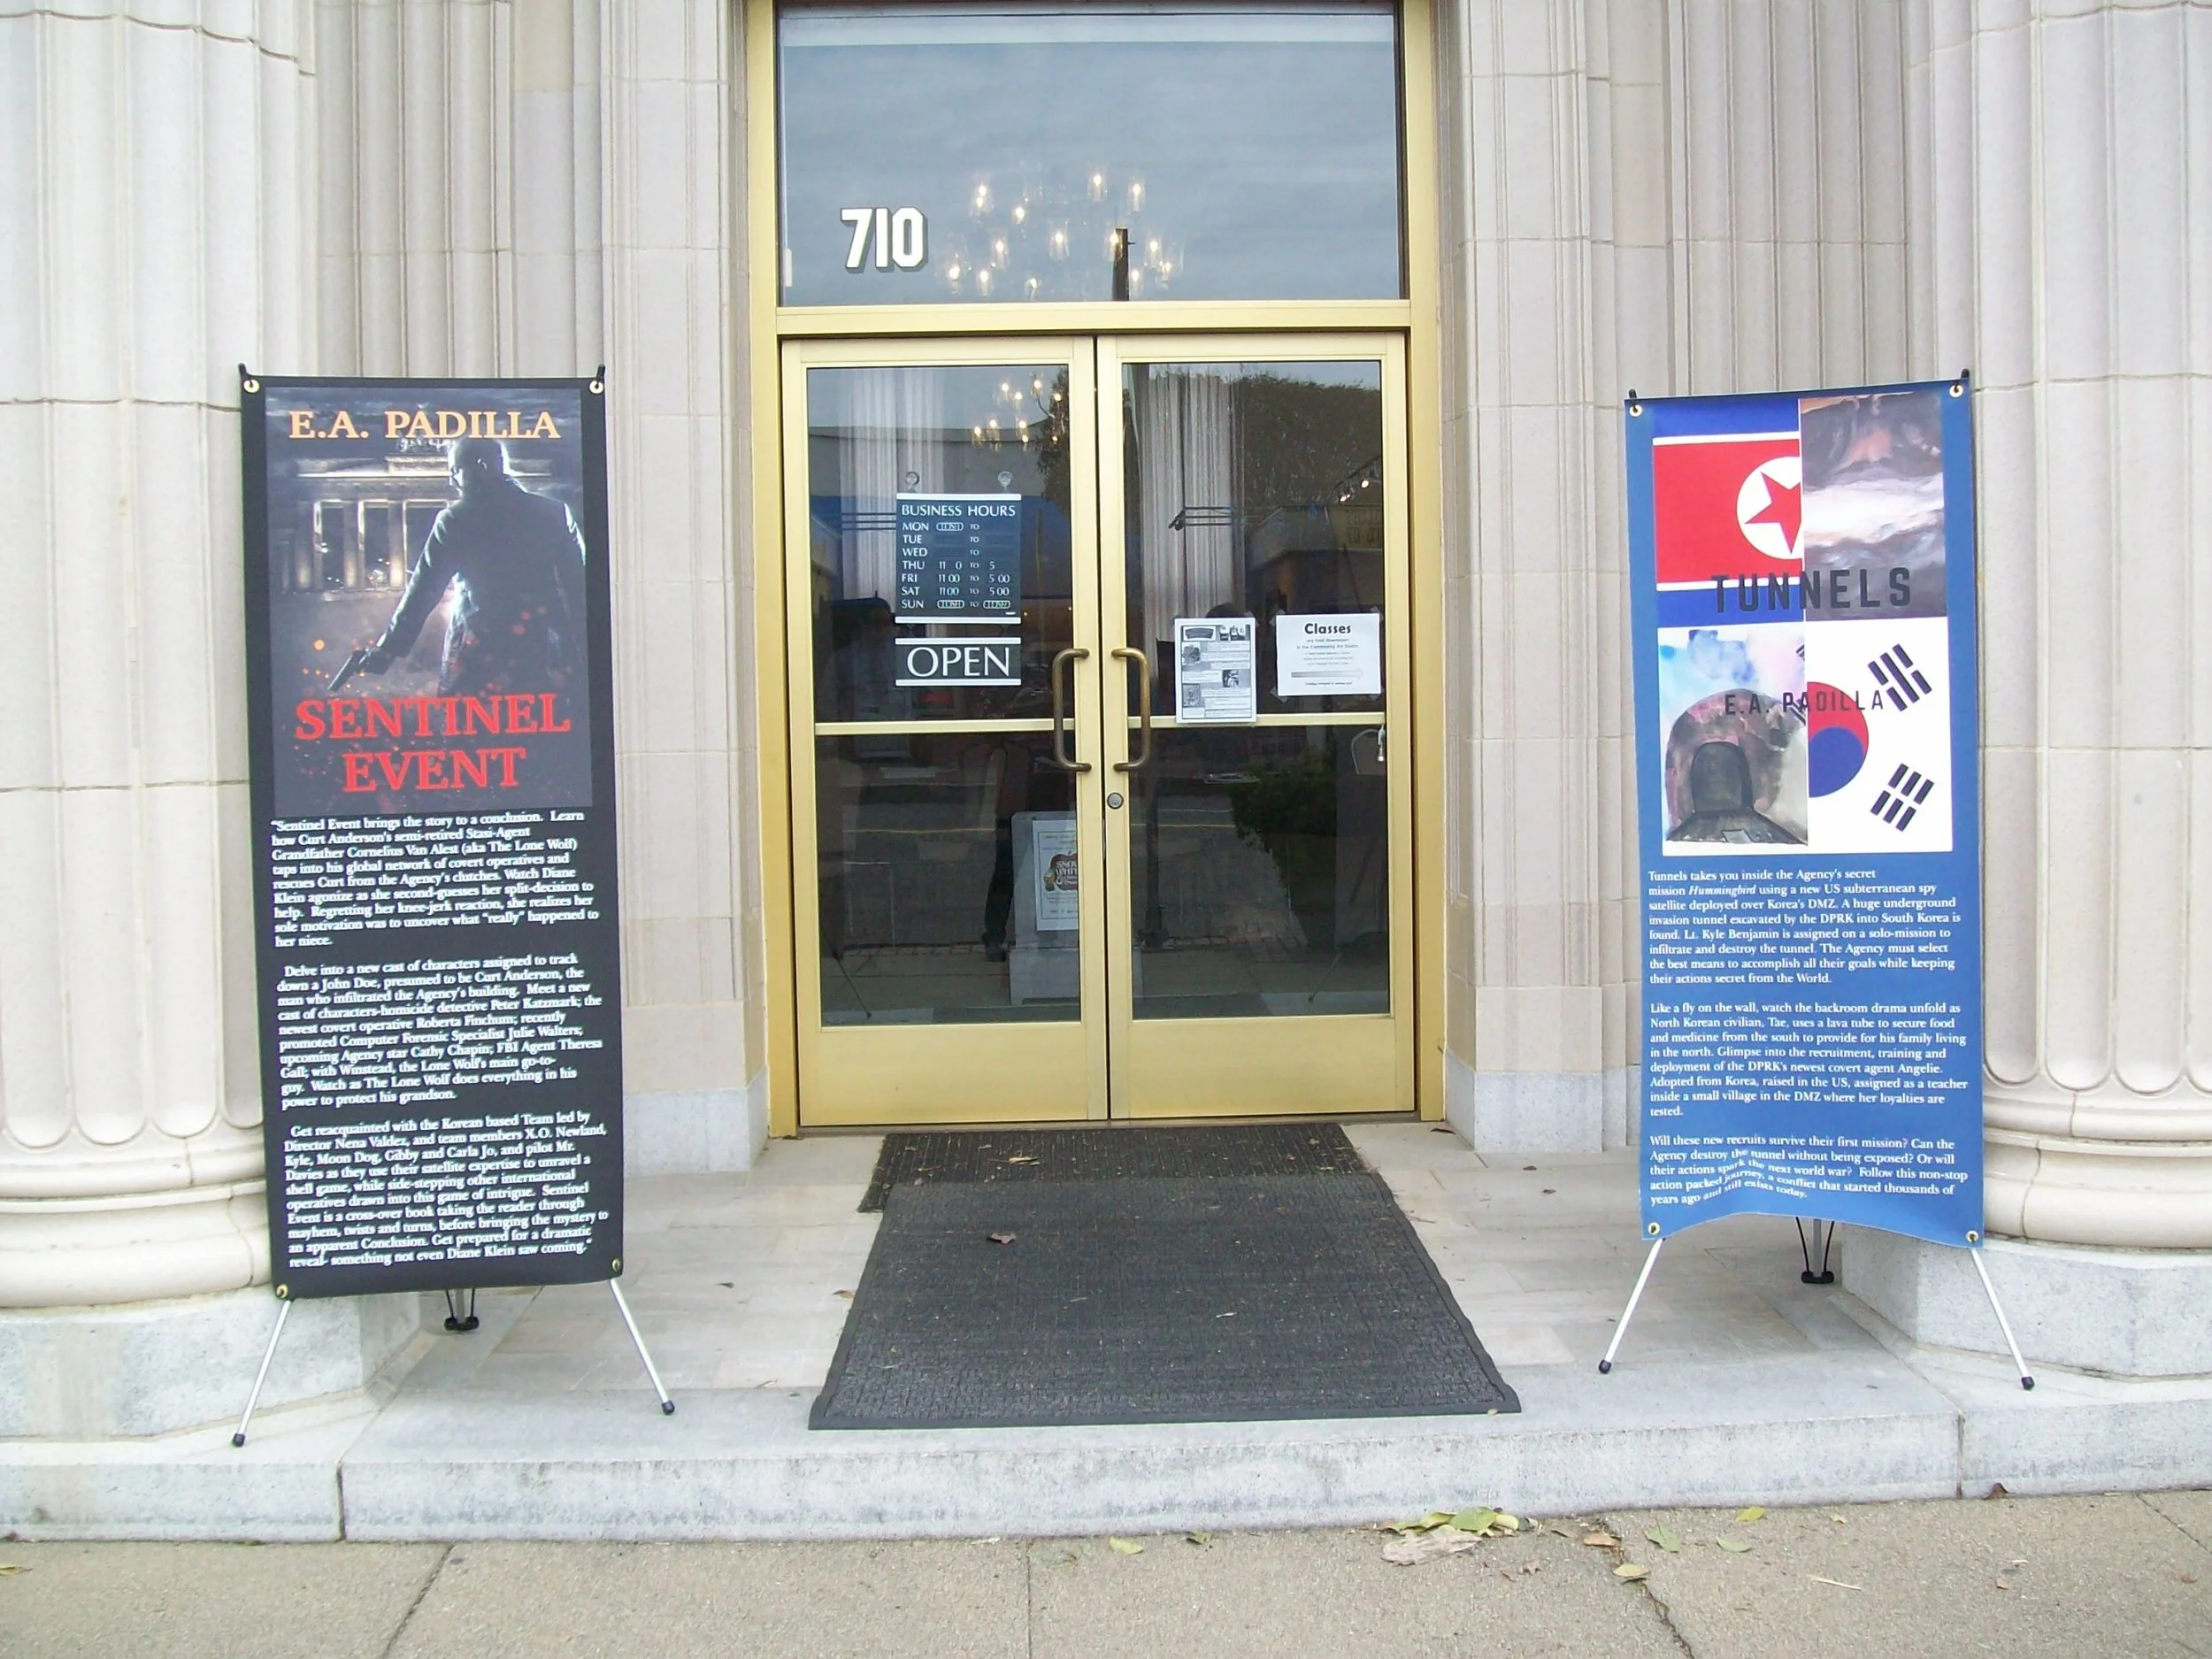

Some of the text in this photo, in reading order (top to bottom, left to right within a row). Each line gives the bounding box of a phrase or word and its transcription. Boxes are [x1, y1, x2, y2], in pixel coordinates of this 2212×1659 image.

[841, 207, 926, 270] 710
[288, 410, 561, 439] E.A. PADILLA
[902, 504, 1016, 517] BUSINESS HOURS
[902, 522, 929, 531] MON
[902, 534, 923, 544] TUE
[902, 548, 928, 557] WED
[902, 560, 926, 570] THU
[902, 573, 918, 583] FRI
[902, 587, 921, 595] SAT
[1711, 567, 1911, 612] TUNNELS
[902, 600, 925, 609] SUN
[1304, 623, 1352, 634] Classes
[907, 647, 1010, 677] OPEN
[1724, 689, 1884, 716] E.A. PADILLA
[296, 693, 571, 740] SENTINEL
[342, 748, 526, 793] EVENT
[1647, 870, 1687, 880] Tunnels
[1690, 870, 1717, 880] takes
[1719, 872, 1739, 882] you
[1741, 869, 1773, 879] inside
[1776, 869, 1793, 879] the
[1796, 868, 1841, 882] Agency's
[1688, 884, 1755, 897] Hummingbird
[1759, 887, 1787, 897] using
[1824, 883, 1840, 894] US
[1843, 882, 1915, 893] subterranean
[1918, 885, 1936, 895] spy
[1648, 899, 1686, 910] satellite
[1688, 899, 1738, 912] deployed
[1767, 898, 1804, 909] Korea's
[1841, 898, 1849, 908] A
[1853, 897, 1880, 910] huge
[1883, 896, 1955, 910] underground
[1693, 914, 1726, 925] tunnel
[1730, 913, 1781, 924] excavated
[1784, 913, 1795, 926] by
[1799, 913, 1816, 923] the
[1820, 912, 1854, 923] DPRK
[1856, 914, 1878, 923] into
[1881, 911, 1913, 923] South
[1917, 911, 1948, 922] Korea
[1649, 929, 1680, 940] found.
[1702, 928, 1724, 941] Kyle
[1728, 928, 1778, 941] Benjamin
[1793, 927, 1839, 941] assigned
[1869, 926, 1936, 938] solo-mission
[1650, 1002, 1671, 1013] Like
[1682, 1002, 1694, 1015] fly
[1715, 1002, 1732, 1012] the
[1762, 1002, 1792, 1012] watch
[1794, 1002, 1812, 1012] the
[1815, 1002, 1868, 1012] backroom
[1870, 1002, 1907, 1012] drama
[1909, 1002, 1946, 1013] unfold
[290, 1110, 590, 1138] Get reacquainted with the Korean based Team led by
[1650, 1134, 1670, 1145] Will
[1673, 1134, 1700, 1145] these
[1726, 1135, 1766, 1144] recruits
[1809, 1135, 1833, 1146] their
[1838, 1135, 1858, 1147] first
[1862, 1137, 1908, 1148] mission?
[1910, 1138, 1933, 1148] Can
[1936, 1138, 1954, 1148] the
[284, 1140, 574, 1169] Kyle, Moon Dog, Gibby and Carla Jo, and pilot Mr.
